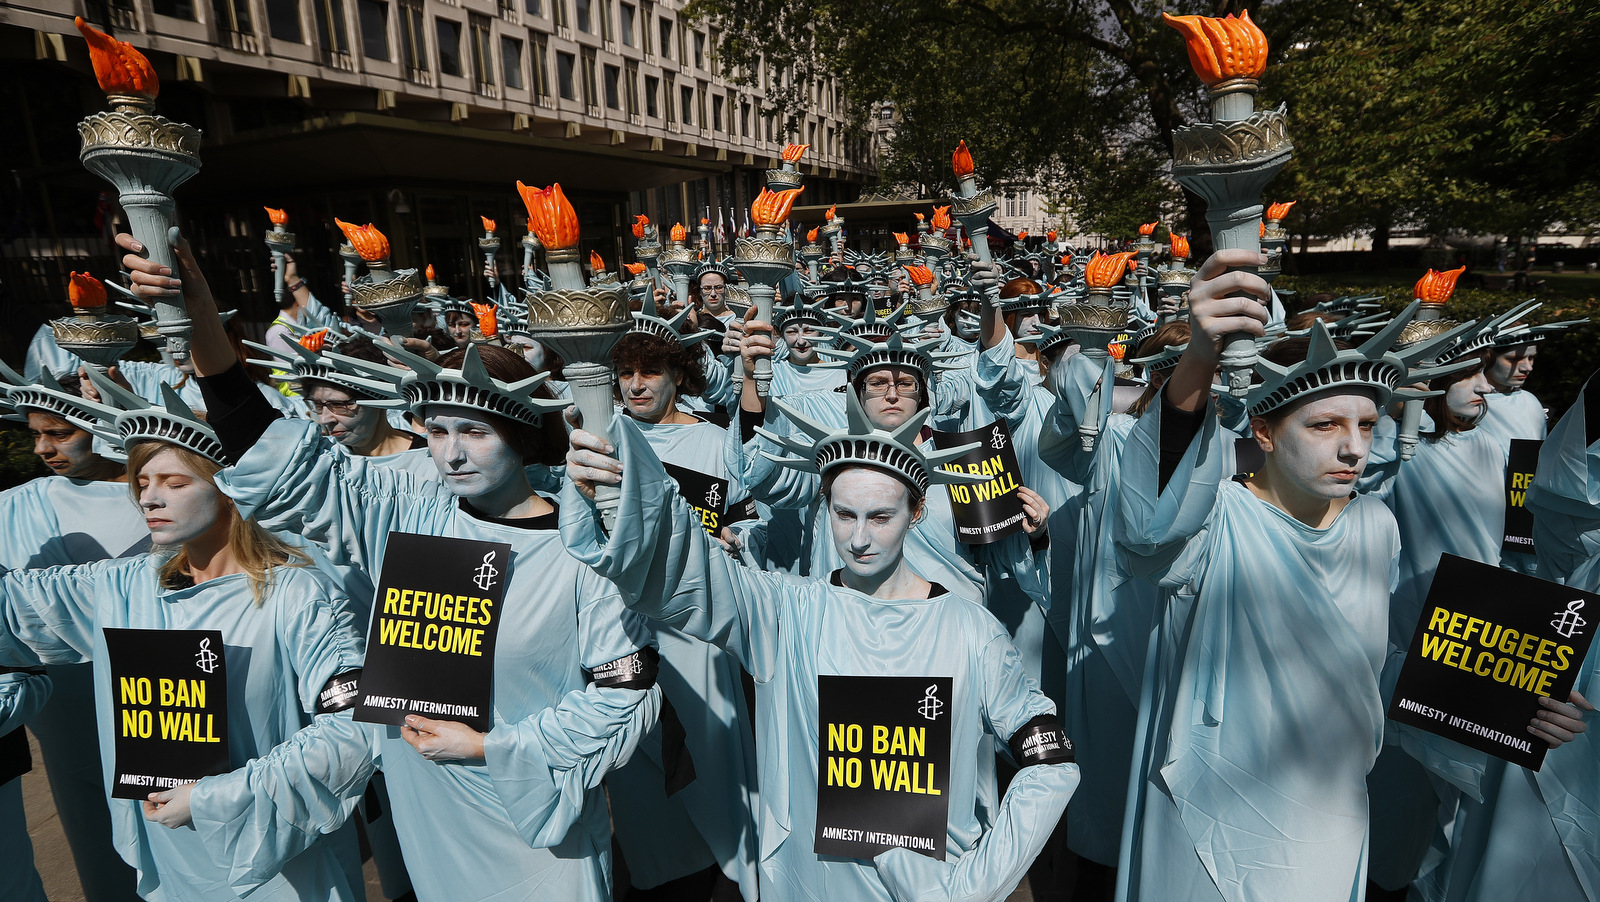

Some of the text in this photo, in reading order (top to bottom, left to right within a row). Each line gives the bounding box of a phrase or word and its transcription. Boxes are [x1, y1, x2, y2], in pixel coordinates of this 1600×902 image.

[968, 455, 1004, 476] BAN
[949, 472, 1019, 504] NO WALL
[960, 511, 1027, 535] AMNESTY INTERNATIONAL
[383, 587, 493, 626] REFUGEES
[379, 618, 485, 657] WELCOME
[1428, 606, 1574, 671] REFUGEES
[1421, 633, 1558, 698] WELCOME
[120, 677, 206, 709] NO BAN
[320, 680, 358, 702] AMNESTY
[363, 695, 479, 717] AMNESTY INTERNATIONAL
[122, 709, 220, 743] NO WALL
[828, 723, 926, 757] NO BAN
[1022, 731, 1057, 750] AMNESTY
[1399, 698, 1532, 754] AMNESTY INTERNATIONAL
[120, 774, 155, 787] AMNESTY
[827, 756, 941, 795] NO WALL
[822, 827, 936, 850] AMNESTY INTERNATIONAL
